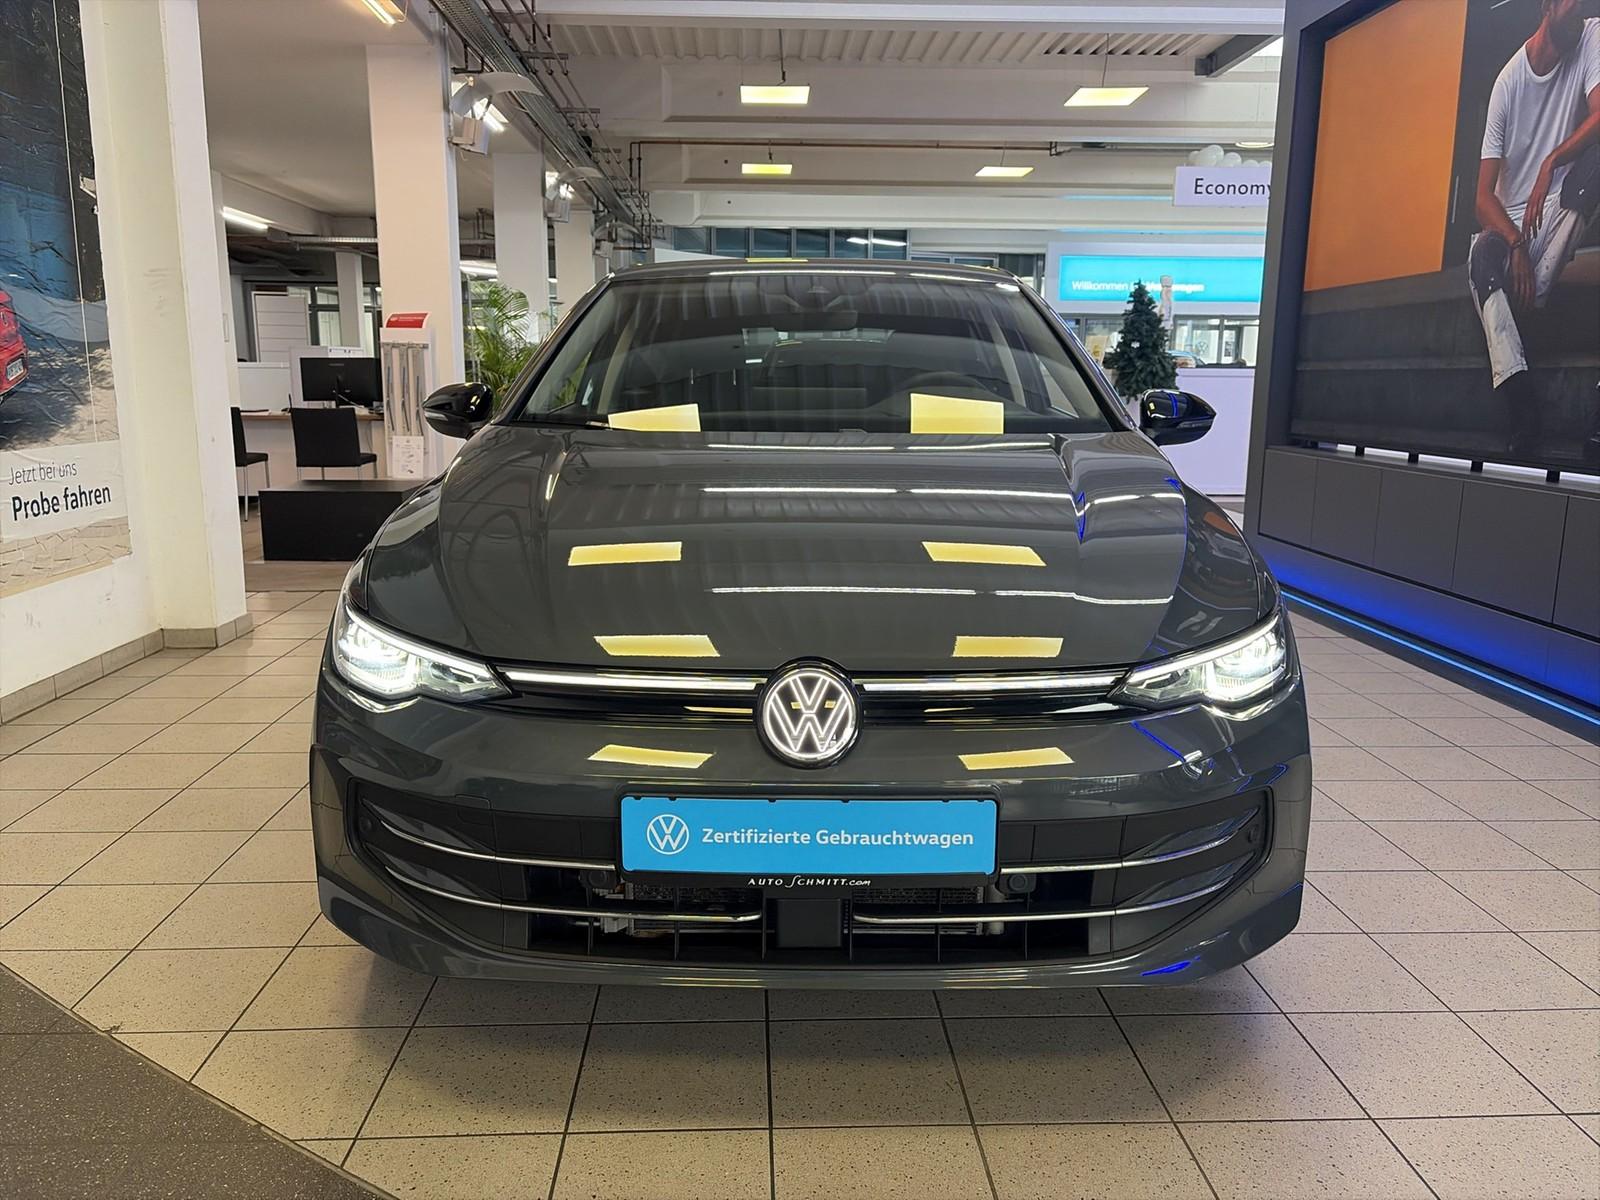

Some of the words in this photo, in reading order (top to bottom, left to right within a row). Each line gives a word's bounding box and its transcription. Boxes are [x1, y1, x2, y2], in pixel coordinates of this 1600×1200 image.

[1071, 280, 1129, 291] Willkommen
[9, 466, 37, 485] Jetzt
[39, 462, 56, 480] bei
[58, 462, 77, 478] uns
[12, 490, 60, 521] Probe
[62, 484, 111, 511] fahren
[701, 828, 811, 844] Zertifizierte
[816, 829, 974, 848] Gebrauchtwagen
[747, 878, 783, 886] AUTO
[785, 874, 871, 888] SCHMITT.com
